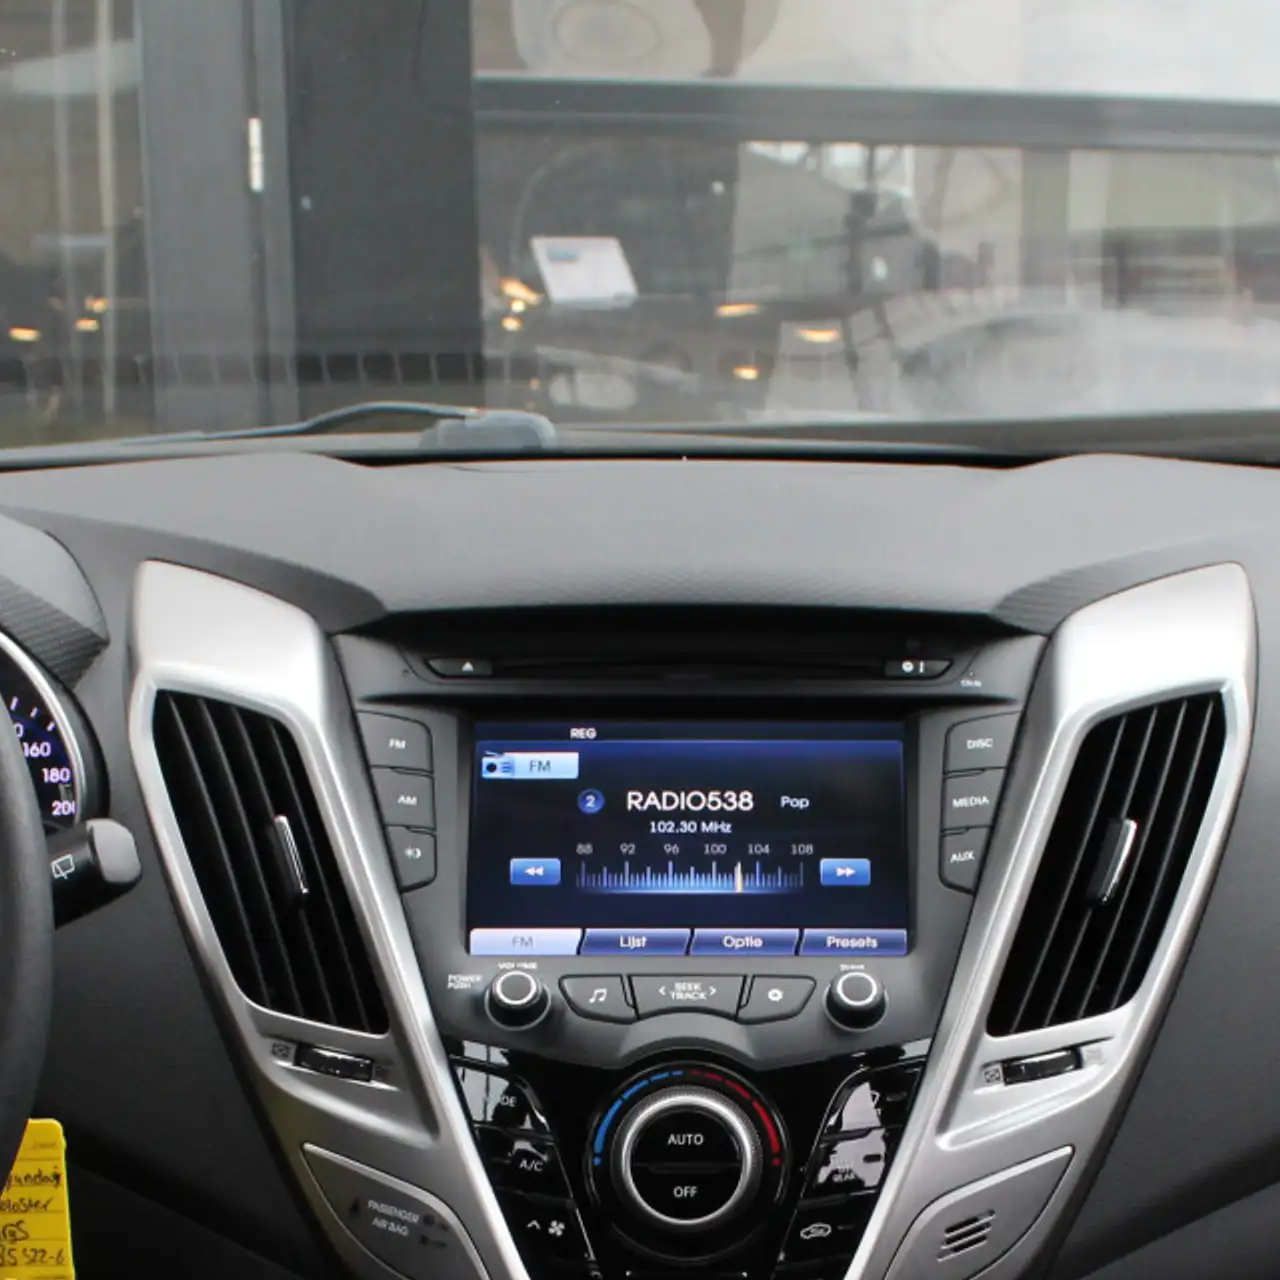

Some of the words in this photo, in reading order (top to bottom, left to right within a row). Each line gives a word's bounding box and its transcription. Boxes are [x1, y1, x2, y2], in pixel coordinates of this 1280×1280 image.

[570, 728, 597, 739] REG
[23, 742, 52, 757] 160
[388, 738, 406, 749] FM
[966, 738, 993, 749] DISC
[529, 759, 551, 772] FM
[42, 768, 70, 782] 180
[586, 796, 596, 807] 2
[627, 791, 754, 811] RADIO538
[780, 796, 810, 809] Pop
[952, 796, 989, 808] MEDIA
[650, 821, 697, 833] 102.30
[701, 821, 732, 833] MHz
[576, 843, 593, 855] 88
[620, 843, 636, 855] 92
[664, 843, 679, 855] 96
[704, 843, 727, 855] 100
[748, 843, 770, 855] 104
[791, 843, 814, 855] 108
[950, 851, 975, 863] AUX
[512, 936, 533, 948] FM
[723, 935, 763, 949] Optie
[826, 936, 878, 949] Presets
[674, 982, 702, 991] SEEK
[671, 990, 707, 1000] TRACK
[668, 1133, 704, 1145] AUTO
[519, 1159, 543, 1172] A/C
[673, 1186, 698, 1198] OFF
[368, 1200, 420, 1224] PASSENGER
